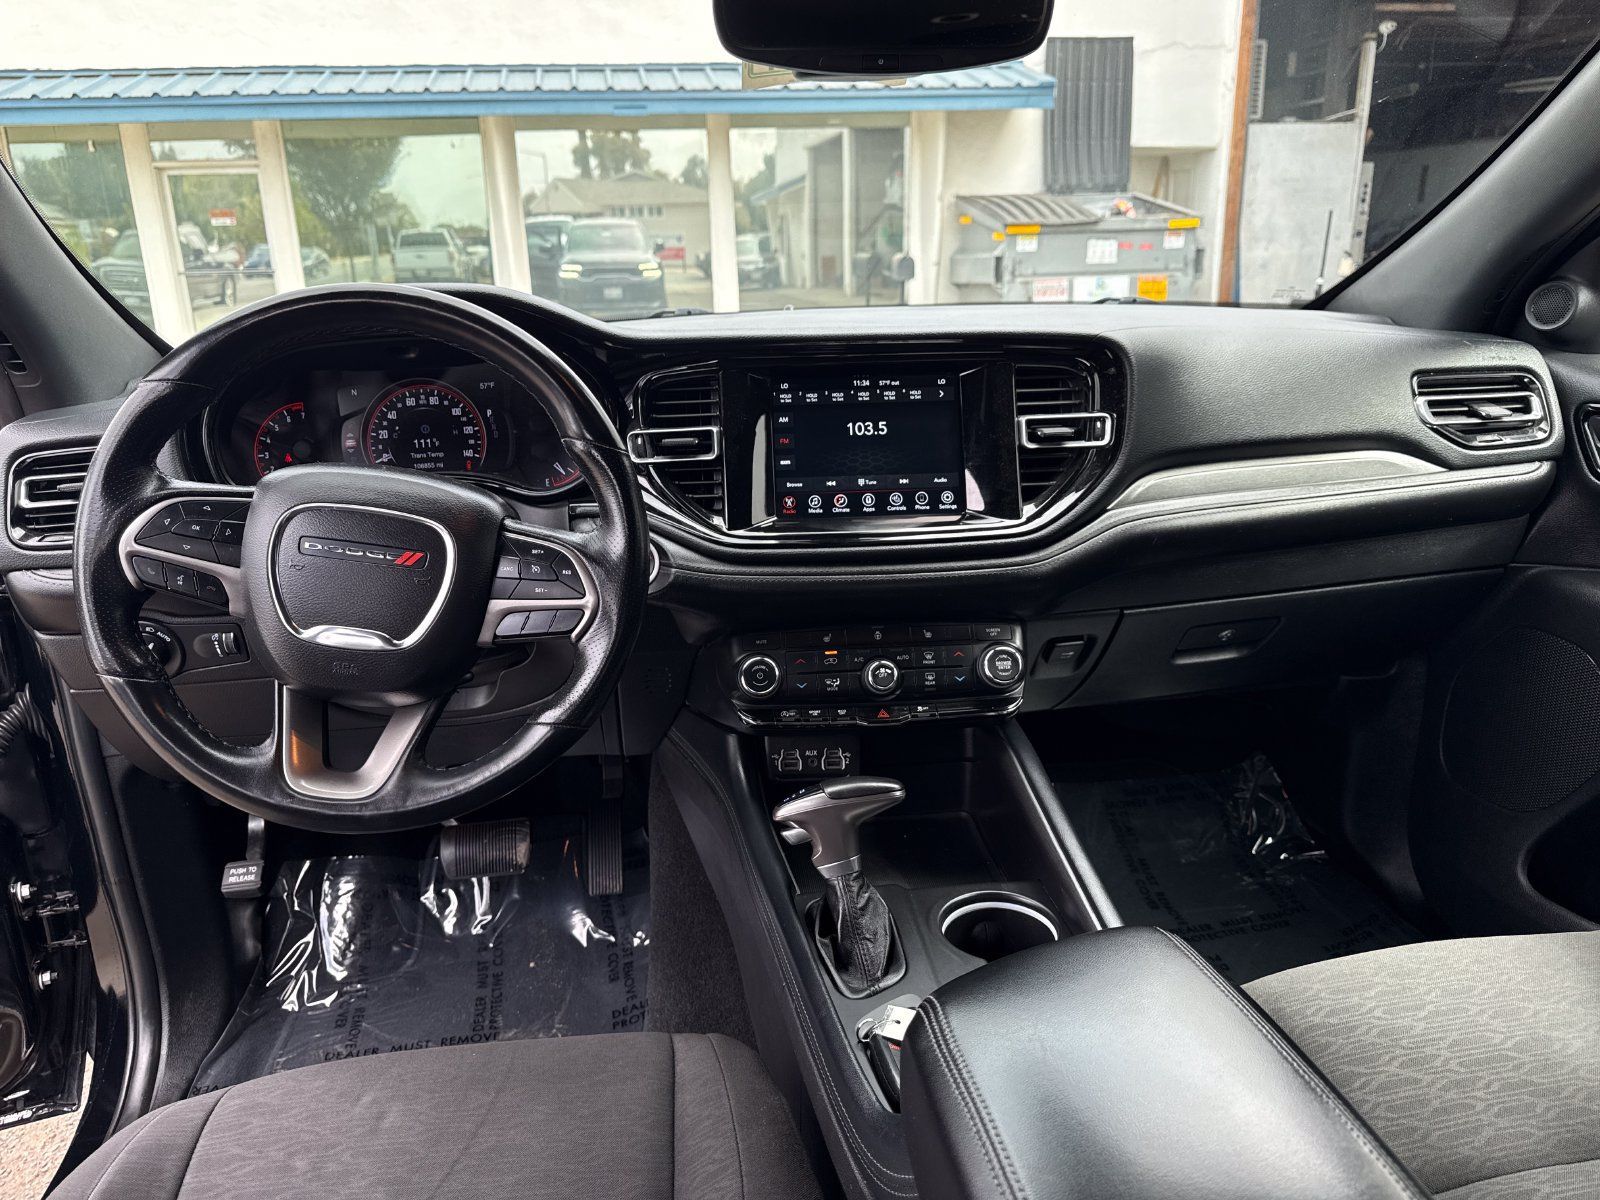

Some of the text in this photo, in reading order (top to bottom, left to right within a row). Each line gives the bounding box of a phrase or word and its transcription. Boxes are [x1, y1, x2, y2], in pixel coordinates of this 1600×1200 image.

[480, 382, 495, 390] 57°F
[406, 397, 416, 406] 60
[429, 396, 439, 405] 80
[300, 412, 305, 420] 7
[387, 410, 396, 419] 40
[452, 407, 461, 416] 100
[487, 409, 492, 417] P
[846, 421, 887, 436] 103.5
[379, 430, 388, 439] 20
[463, 449, 474, 457] 140
[546, 478, 550, 486] E
[156, 632, 171, 642] AUTO
[229, 874, 256, 882] RELEASE
